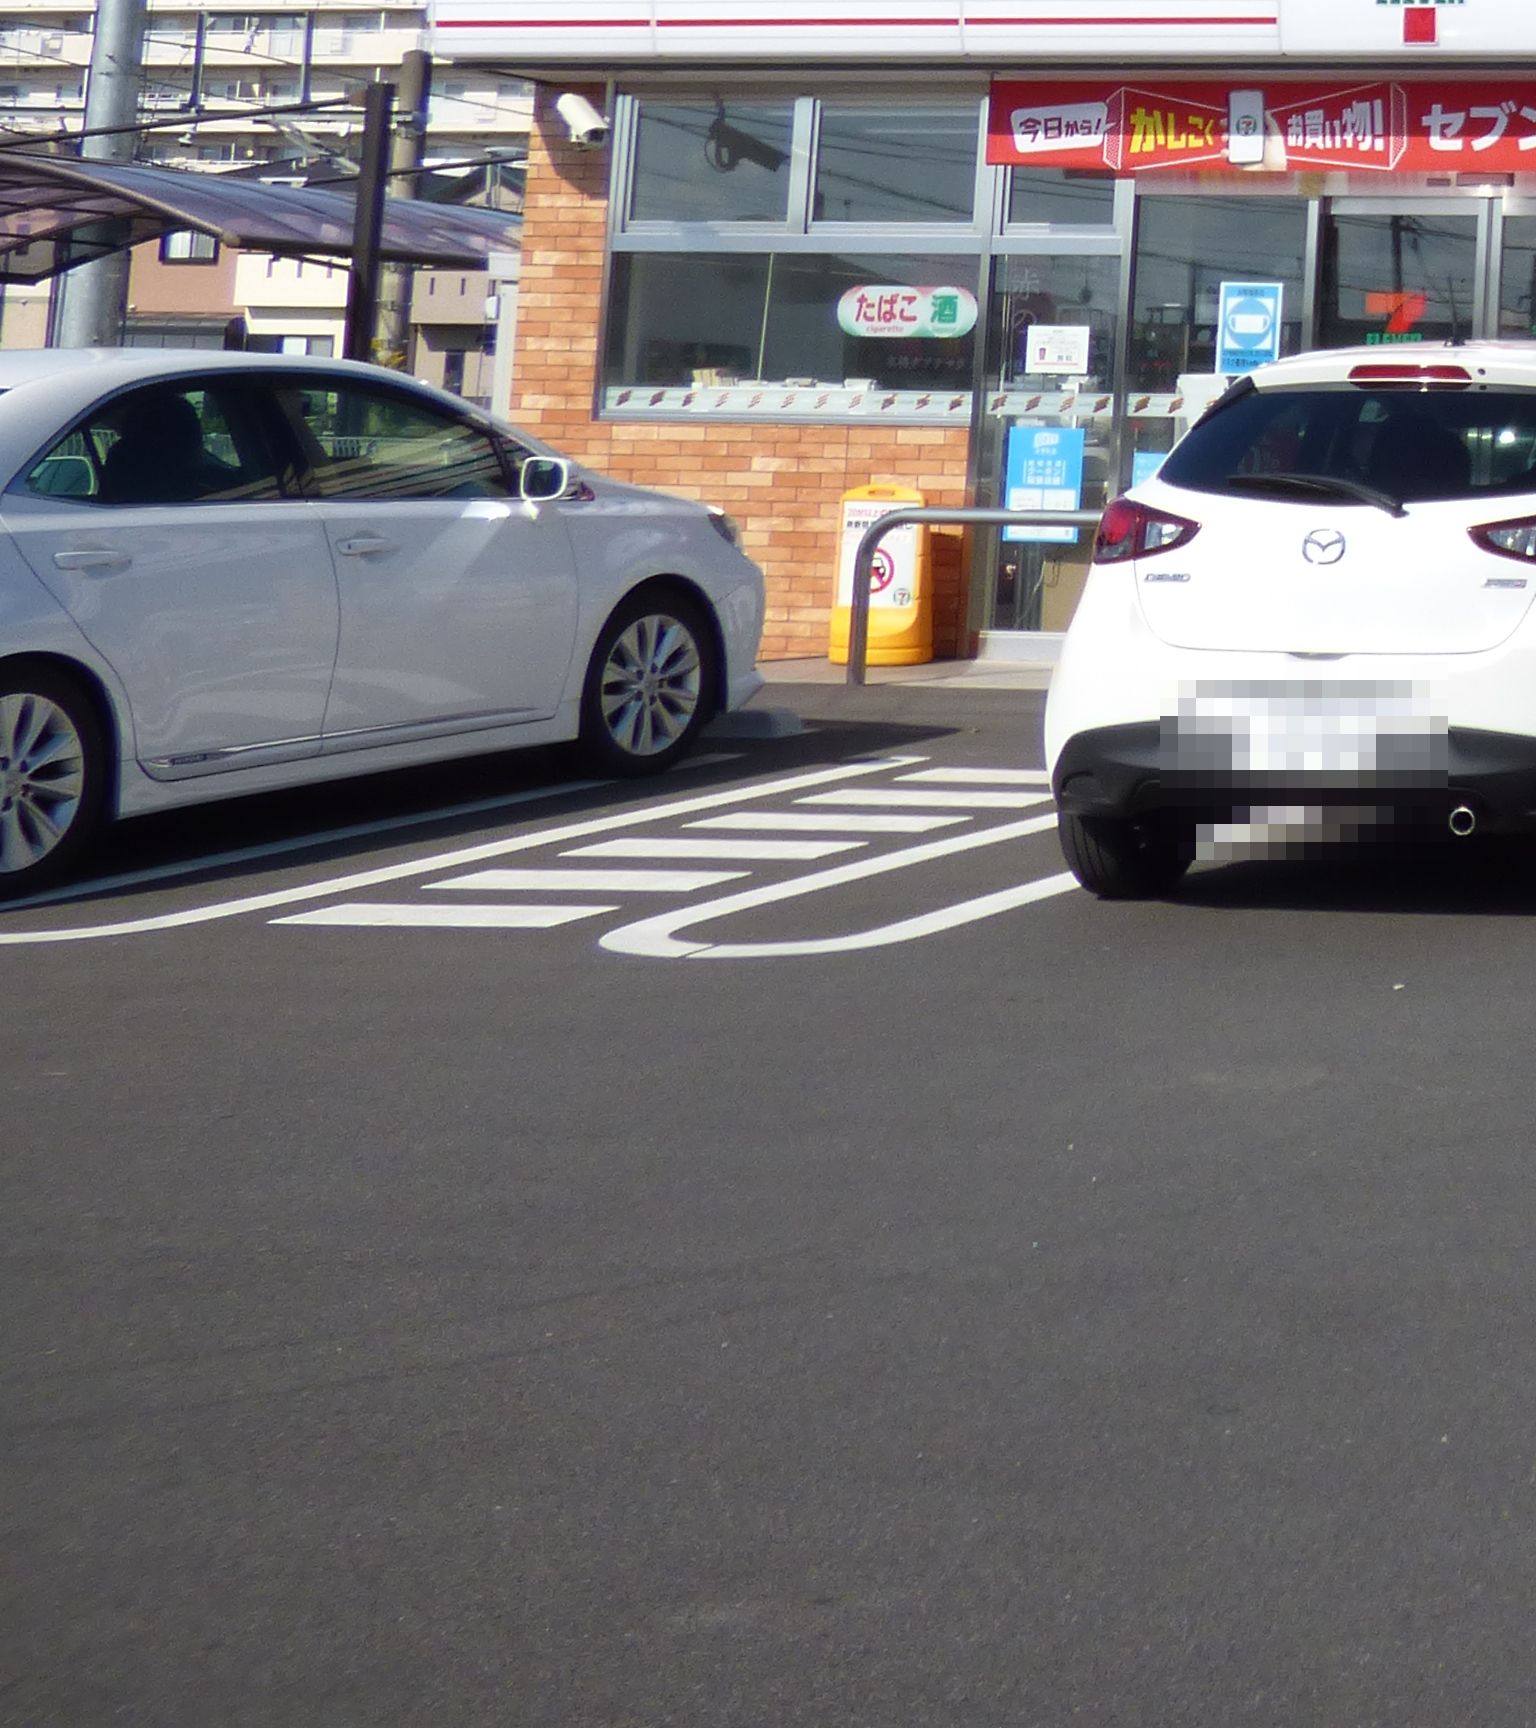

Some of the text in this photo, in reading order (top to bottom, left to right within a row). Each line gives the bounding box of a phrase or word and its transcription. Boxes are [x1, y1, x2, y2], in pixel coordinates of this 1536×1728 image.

[1129, 106, 1215, 154] かしこく
[1287, 98, 1385, 152] お買い物!
[855, 293, 959, 324] たばこ 酒
